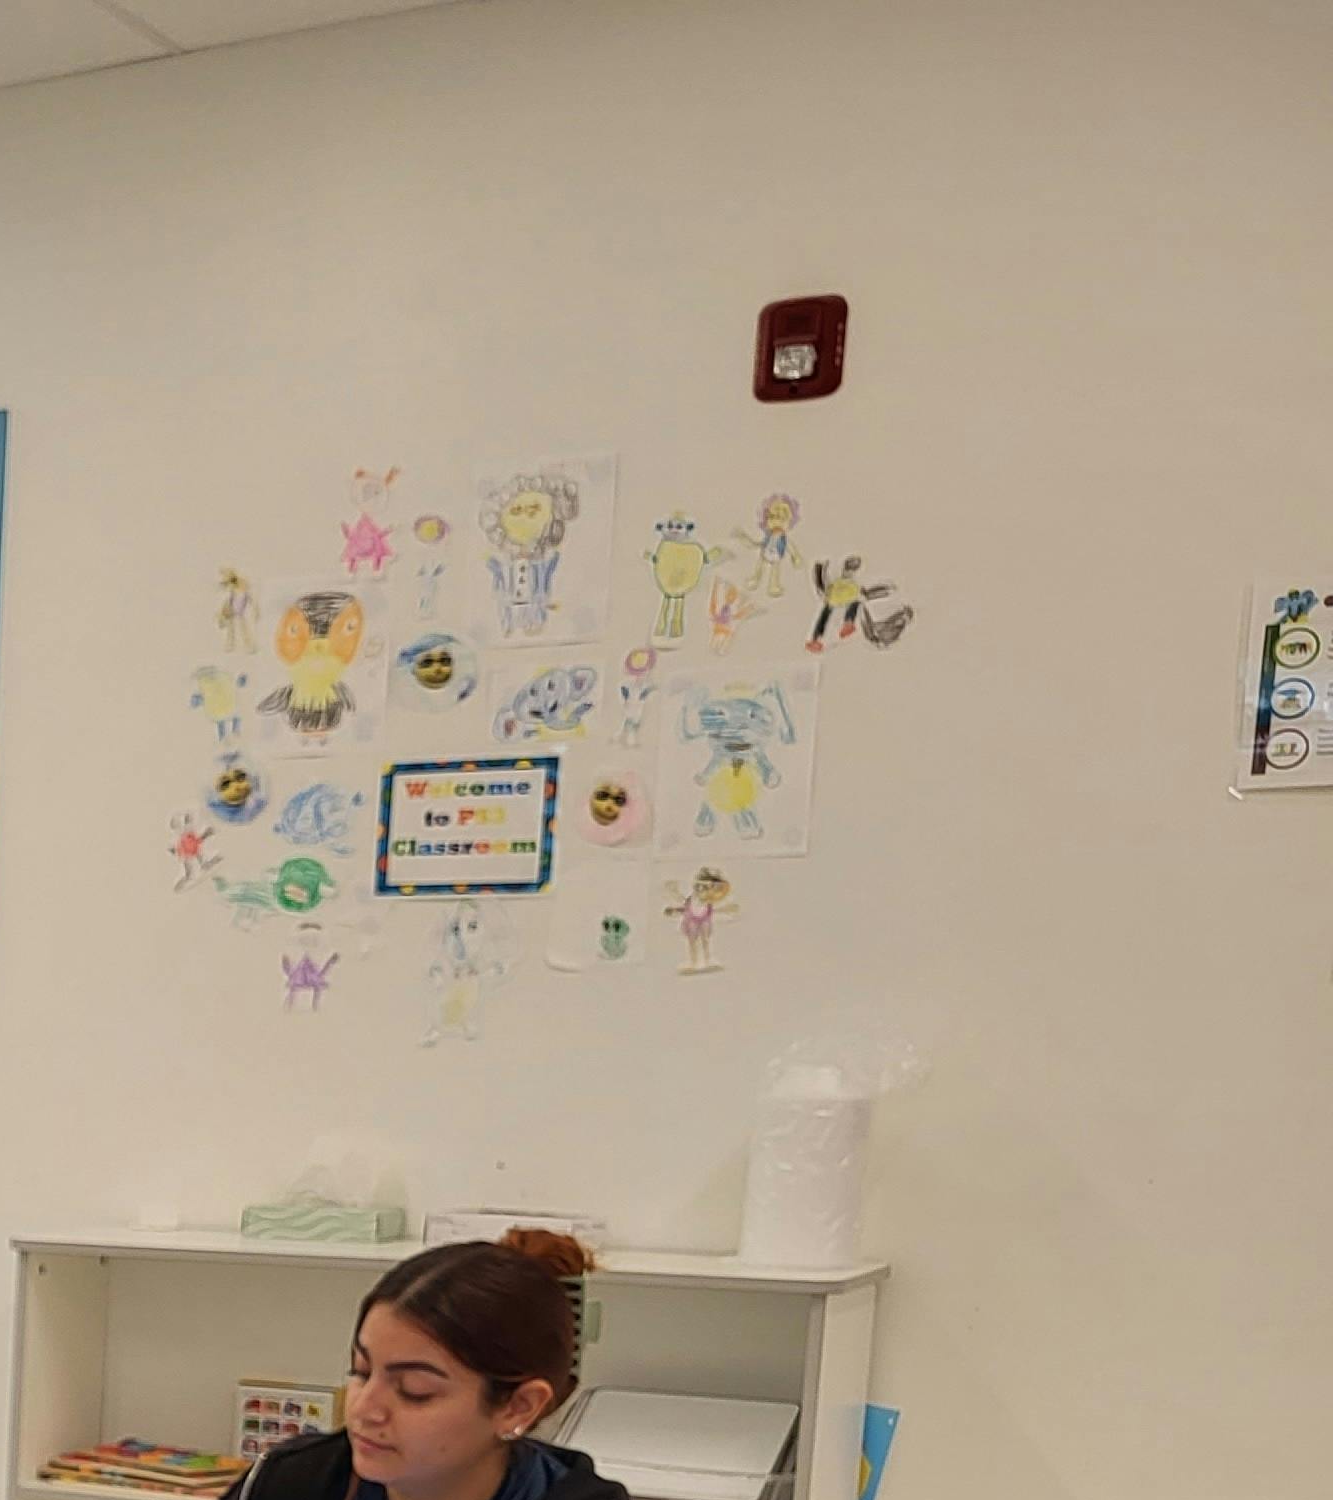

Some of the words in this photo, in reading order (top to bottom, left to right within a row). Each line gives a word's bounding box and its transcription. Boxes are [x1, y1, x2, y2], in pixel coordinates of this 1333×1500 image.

[405, 780, 531, 798] Welcome
[424, 810, 450, 826] to
[392, 839, 537, 857] Classroom
